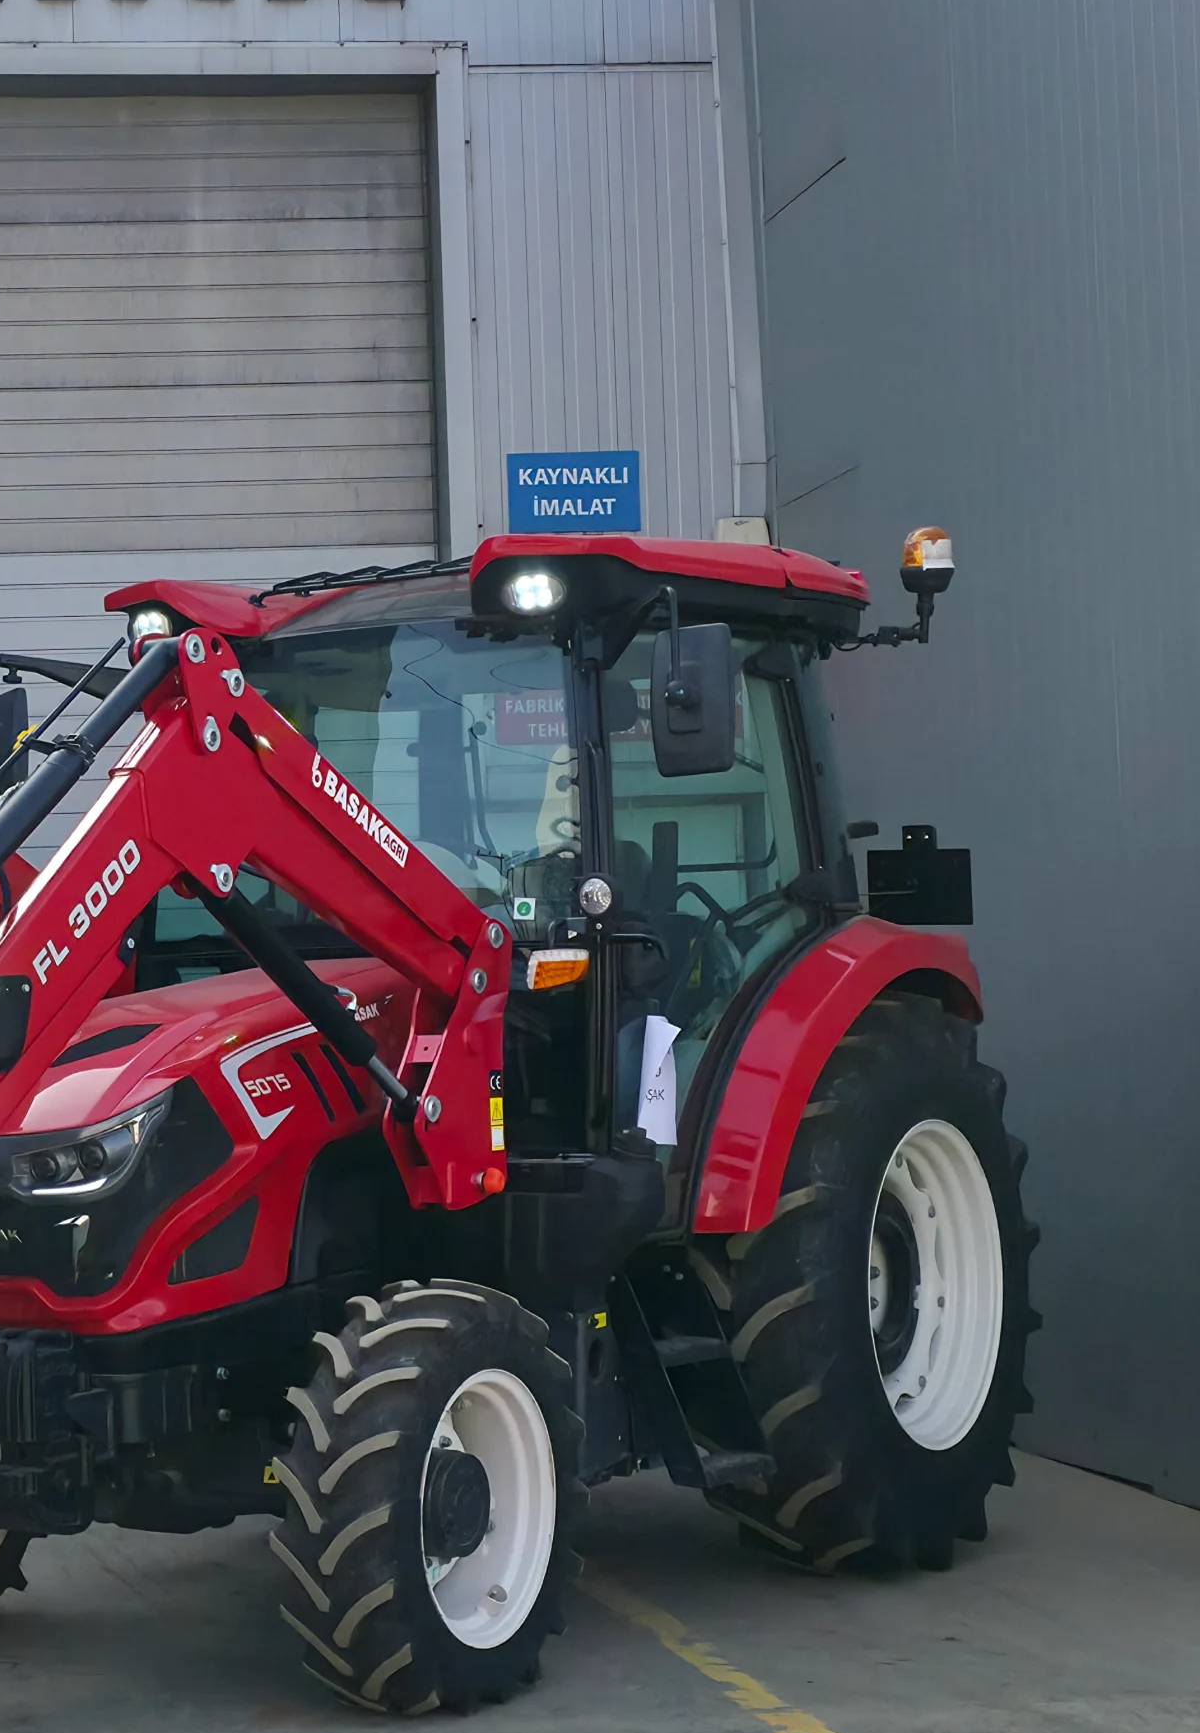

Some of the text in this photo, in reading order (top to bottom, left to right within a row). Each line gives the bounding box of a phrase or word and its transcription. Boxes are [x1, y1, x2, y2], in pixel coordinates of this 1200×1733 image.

[518, 467, 629, 486] KAYNAKLI
[533, 495, 617, 516] İMALAT
[505, 695, 565, 715] FABRİK
[527, 721, 568, 739] TEHL
[323, 769, 406, 862] BASAK AGRI
[32, 839, 141, 985] FL 3000
[354, 1003, 380, 1022] ASAK
[244, 1073, 292, 1098] 5075
